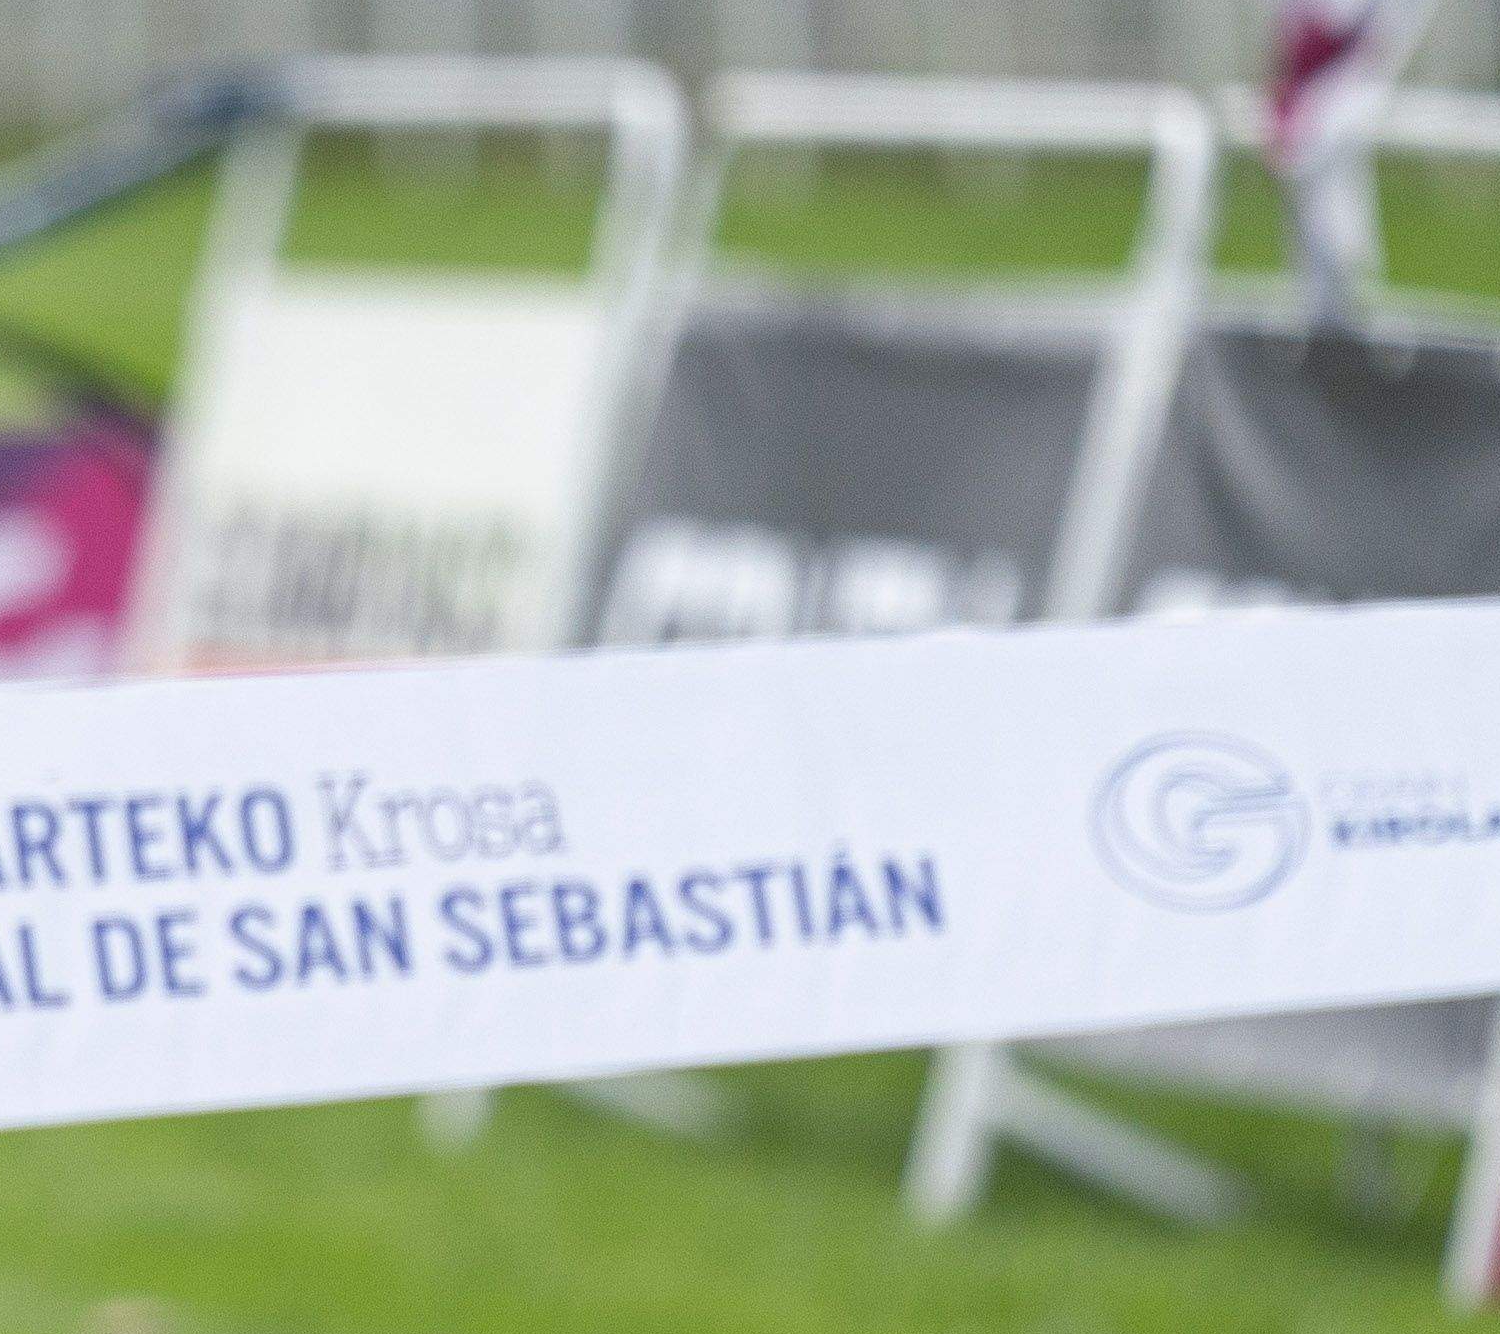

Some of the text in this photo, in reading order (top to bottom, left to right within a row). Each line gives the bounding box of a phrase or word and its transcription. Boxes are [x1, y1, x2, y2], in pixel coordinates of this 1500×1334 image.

[315, 771, 564, 873] Krosa
[90, 907, 206, 1005] DE
[229, 893, 413, 993] SAN
[438, 841, 946, 975] SEBASTIÁN
